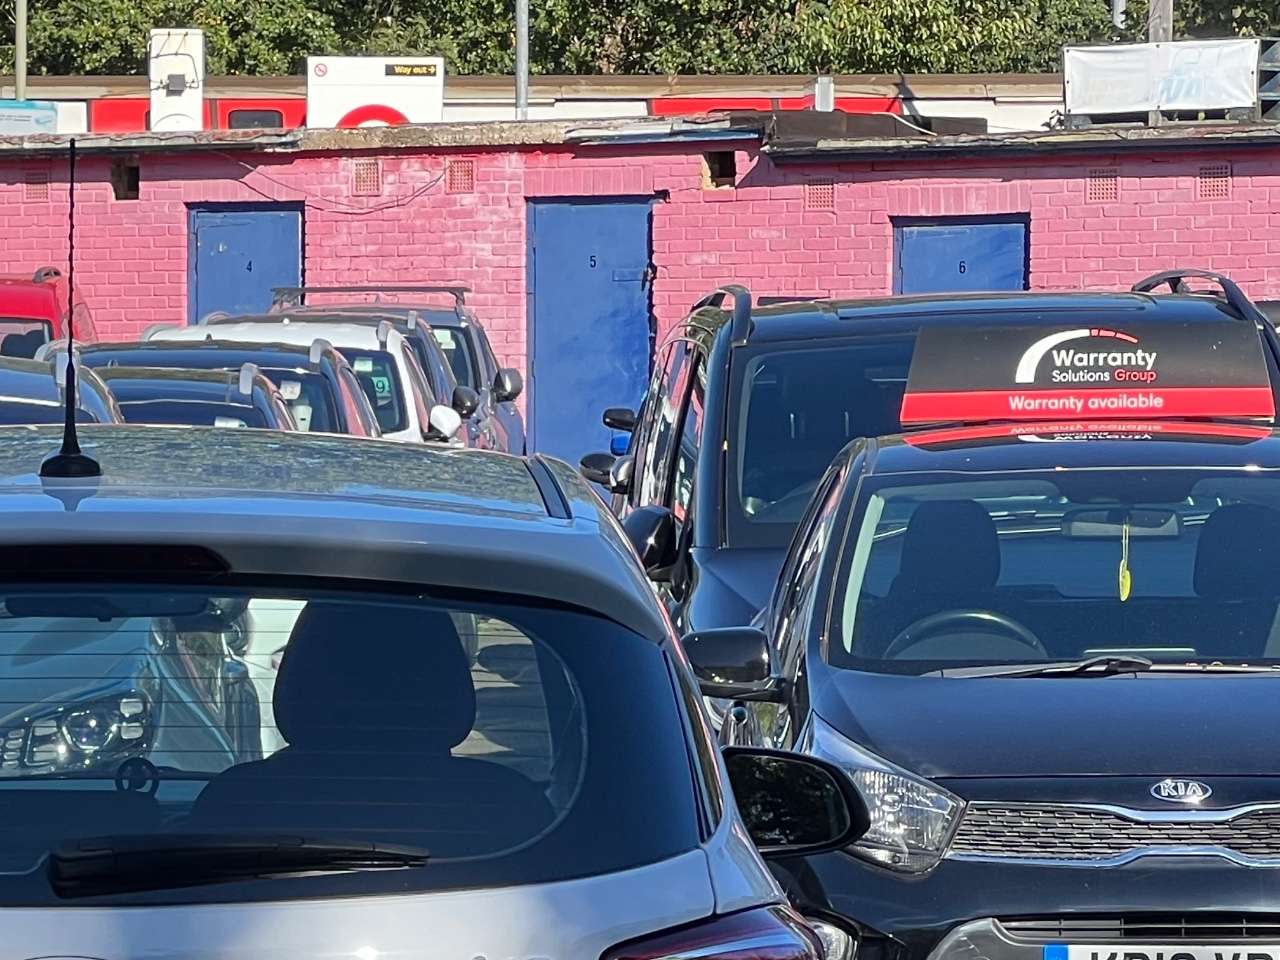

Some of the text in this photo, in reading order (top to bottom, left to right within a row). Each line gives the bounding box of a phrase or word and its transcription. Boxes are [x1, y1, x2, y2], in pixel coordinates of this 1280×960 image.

[394, 65, 427, 75] Way out
[246, 260, 253, 273] 4
[589, 255, 597, 268] 5
[958, 260, 966, 274] 6
[1051, 348, 1157, 371] Warranty
[1051, 369, 1157, 383] Solutions Group
[1008, 394, 1163, 412] Warranty available
[1160, 782, 1204, 797] KIA
